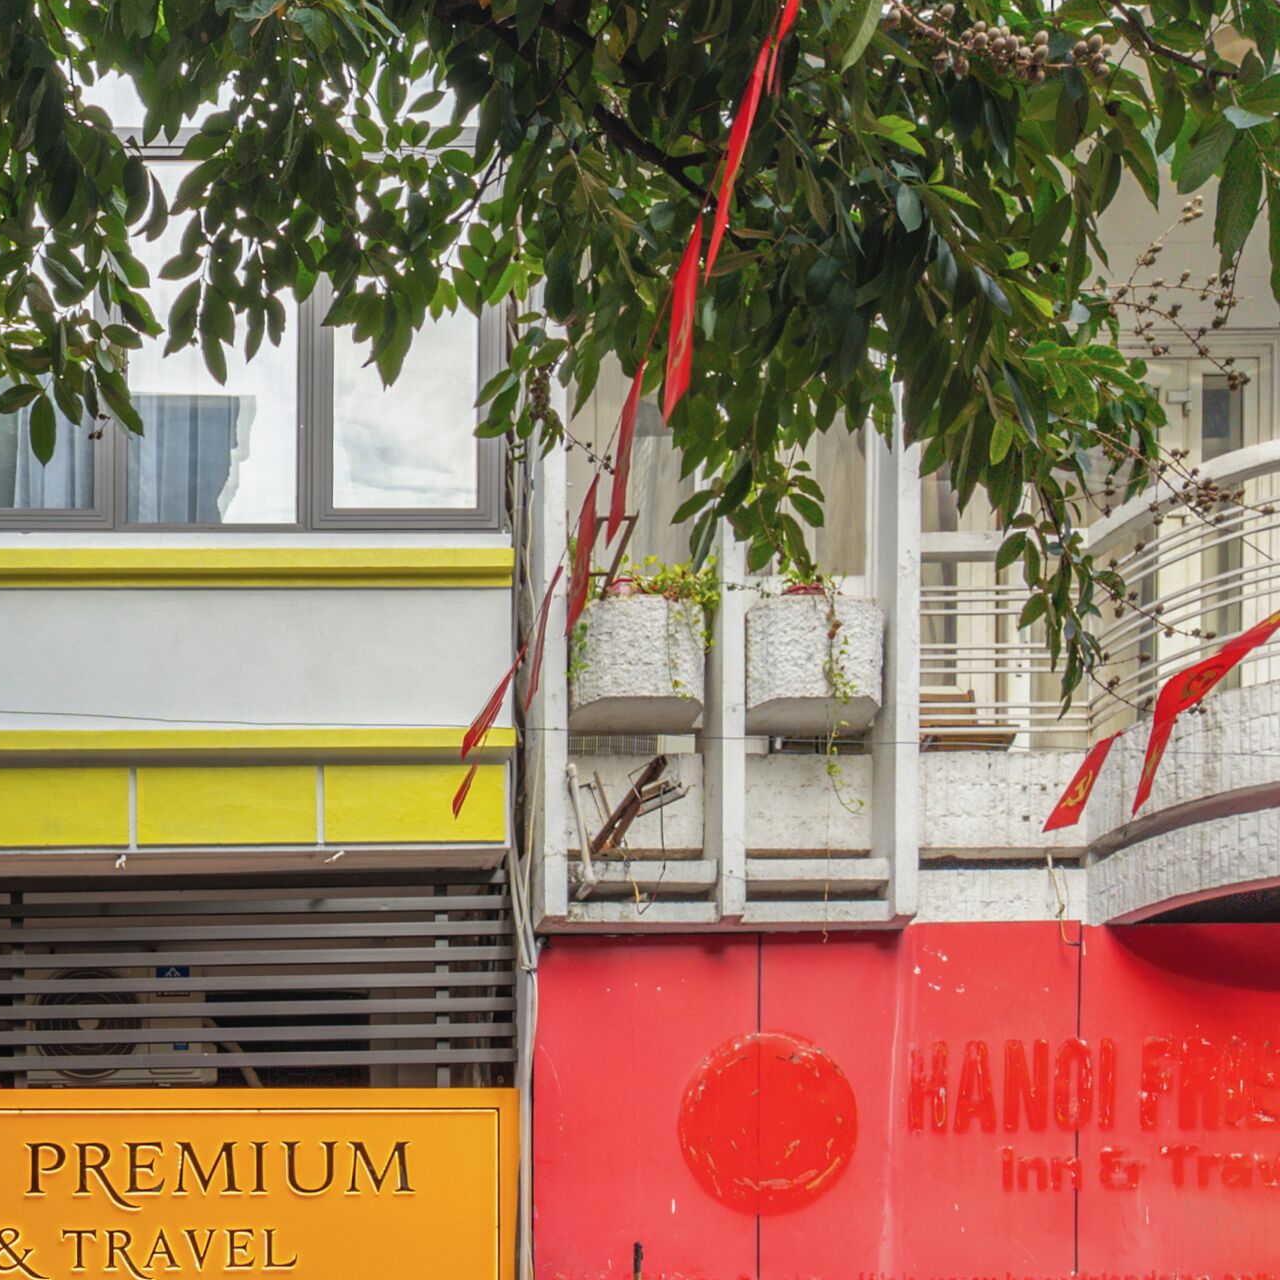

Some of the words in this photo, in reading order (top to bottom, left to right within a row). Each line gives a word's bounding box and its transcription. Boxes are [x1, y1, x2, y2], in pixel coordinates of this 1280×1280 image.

[907, 1037, 1118, 1134] HANOI
[24, 1140, 417, 1211] PREMIUM
[1001, 1145, 1083, 1193] Inn
[1099, 1146, 1148, 1192] &
